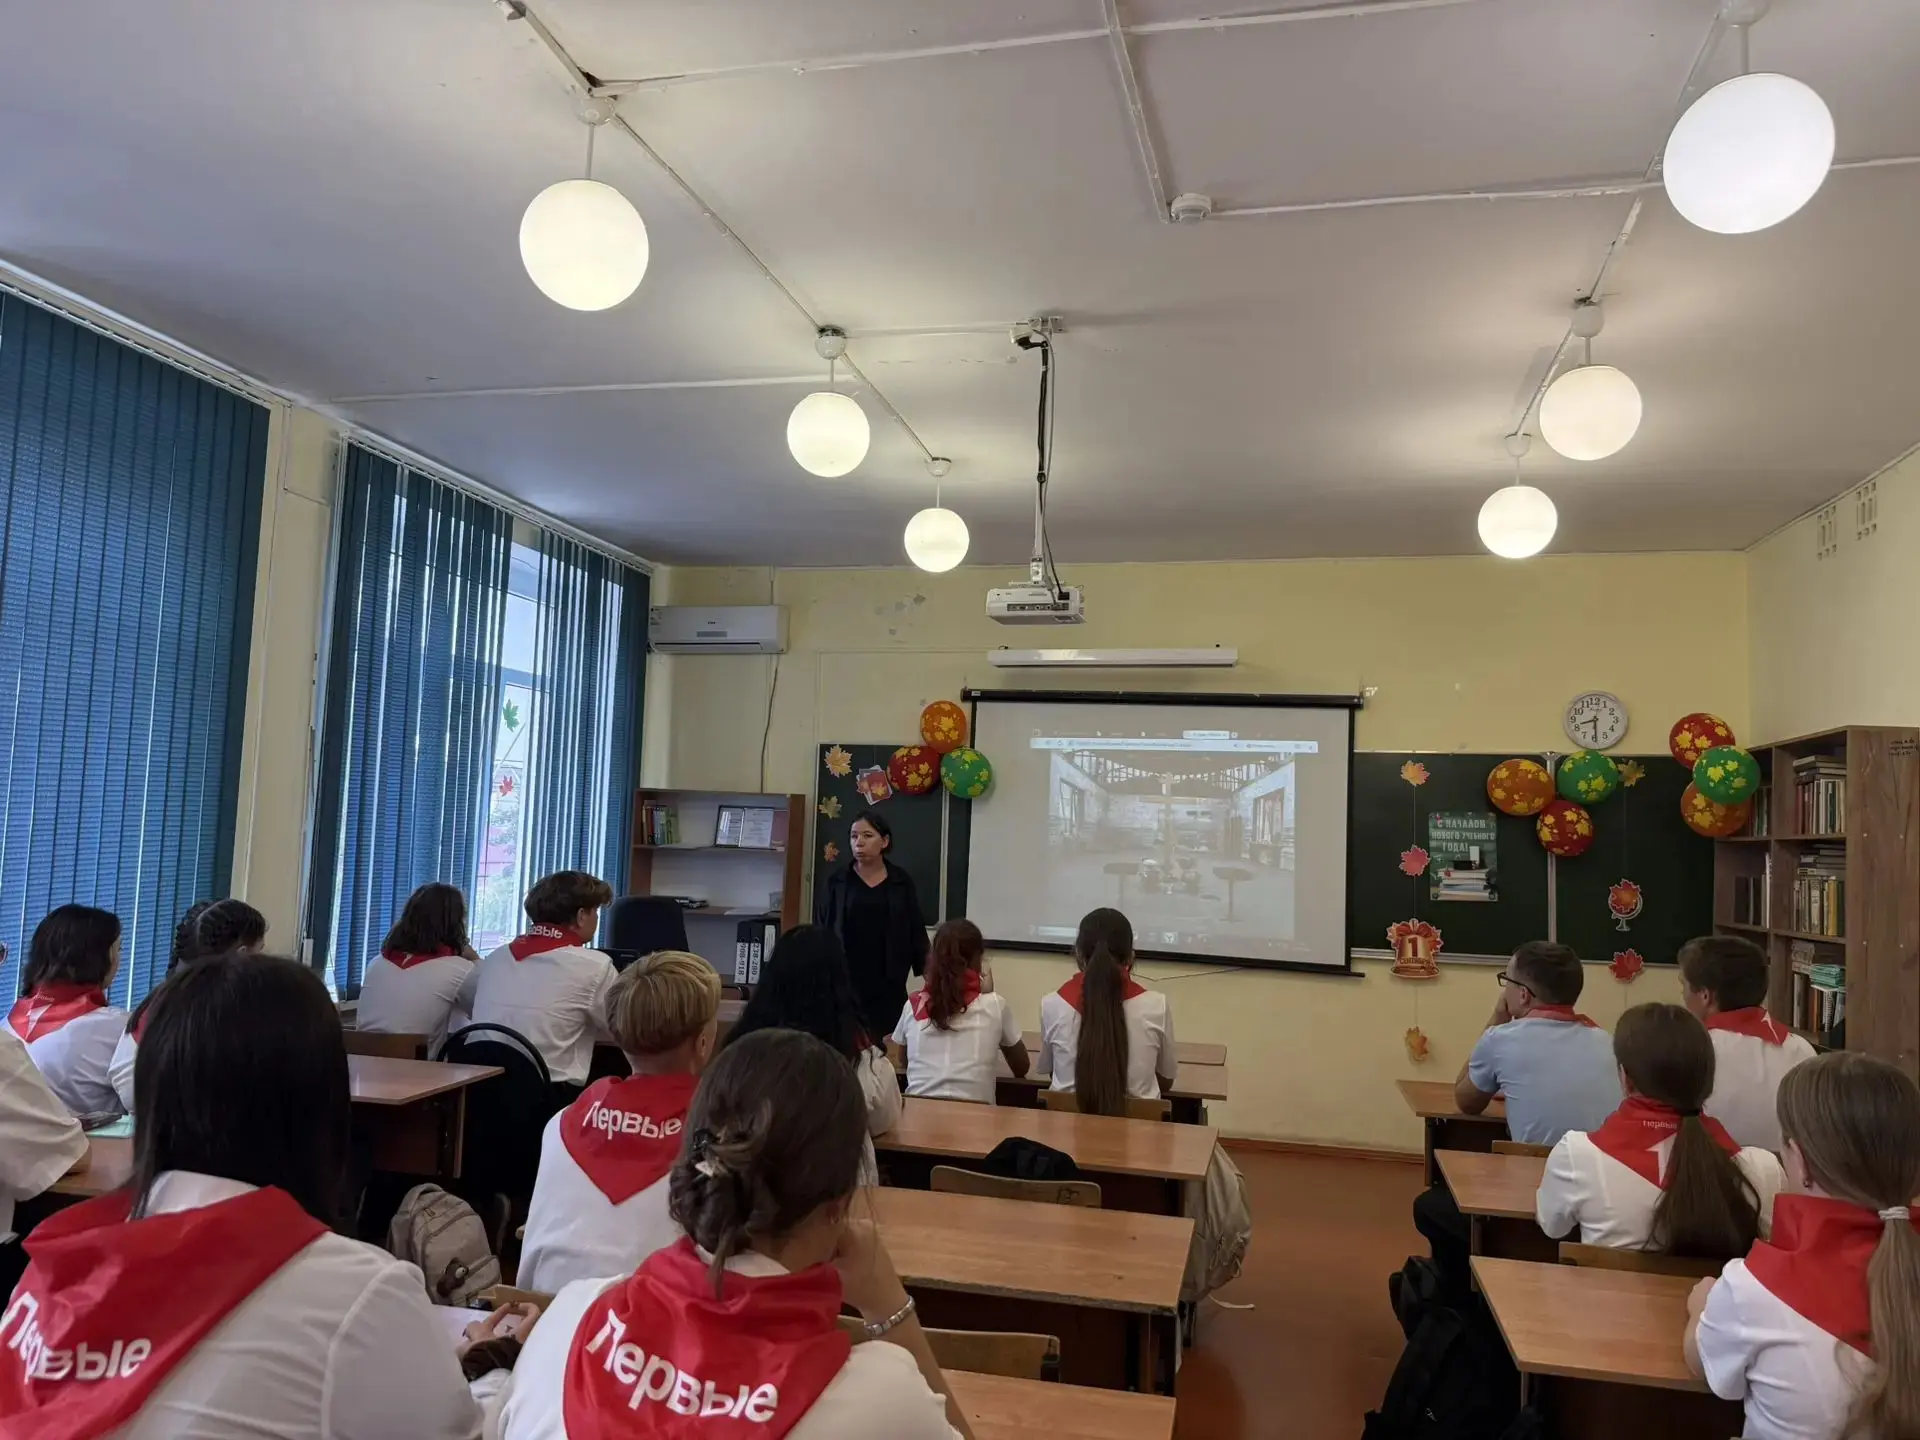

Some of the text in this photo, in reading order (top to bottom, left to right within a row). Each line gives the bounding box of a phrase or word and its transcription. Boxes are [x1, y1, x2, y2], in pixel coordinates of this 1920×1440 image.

[1581, 700, 1590, 708] 11
[1574, 707, 1584, 716] 10
[1609, 708, 1615, 716] 2
[1613, 716, 1619, 724] 3
[1574, 724, 1580, 732] 8
[1602, 732, 1608, 740] 5
[1431, 831, 1460, 840] НОВОГО
[1408, 936, 1418, 958] 1
[585, 1308, 779, 1423] Первые
